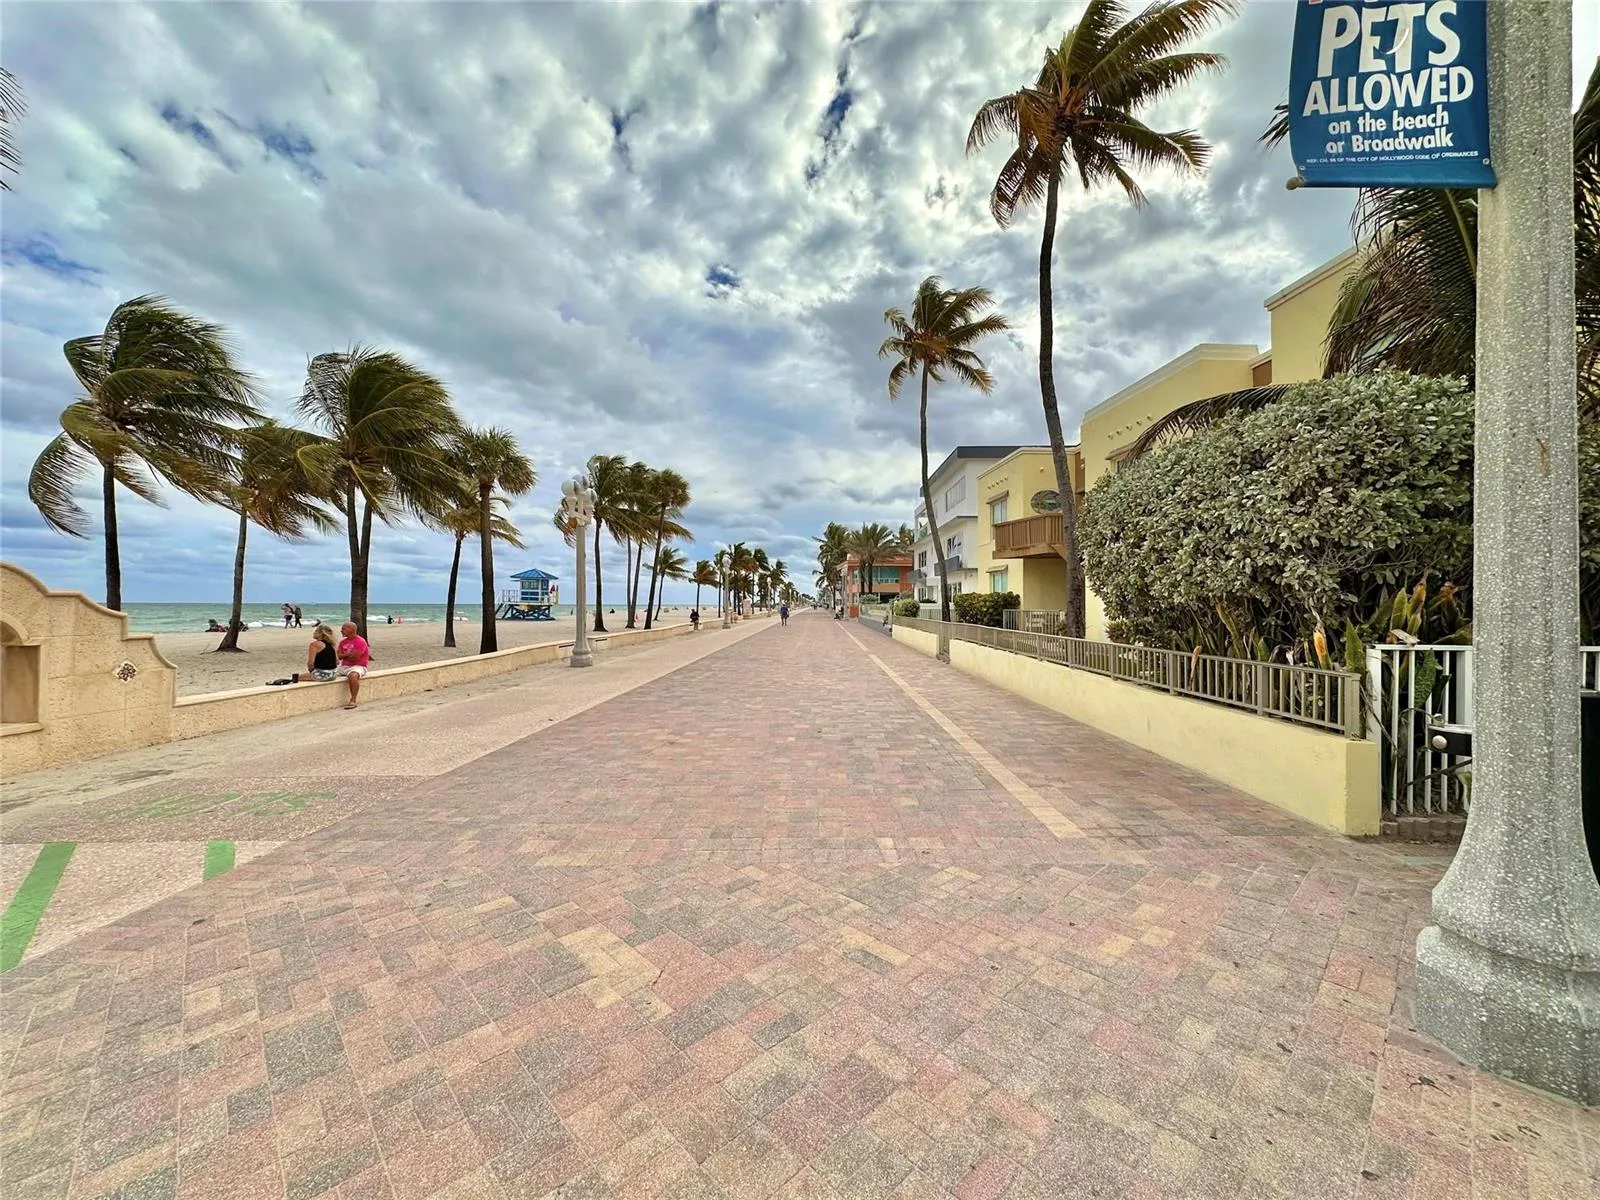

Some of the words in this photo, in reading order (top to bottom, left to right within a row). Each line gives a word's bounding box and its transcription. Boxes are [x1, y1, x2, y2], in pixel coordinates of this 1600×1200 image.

[1317, 1, 1460, 78] PETS
[1302, 66, 1474, 117] ALLOWED
[1328, 119, 1351, 135] on
[1357, 112, 1388, 133] the
[1392, 104, 1449, 131] beach
[1325, 141, 1345, 154] or
[1351, 127, 1454, 153] Broadwalk
[1379, 153, 1414, 161] HOLLYWOOD
[1441, 150, 1479, 158] ORDINANCES
